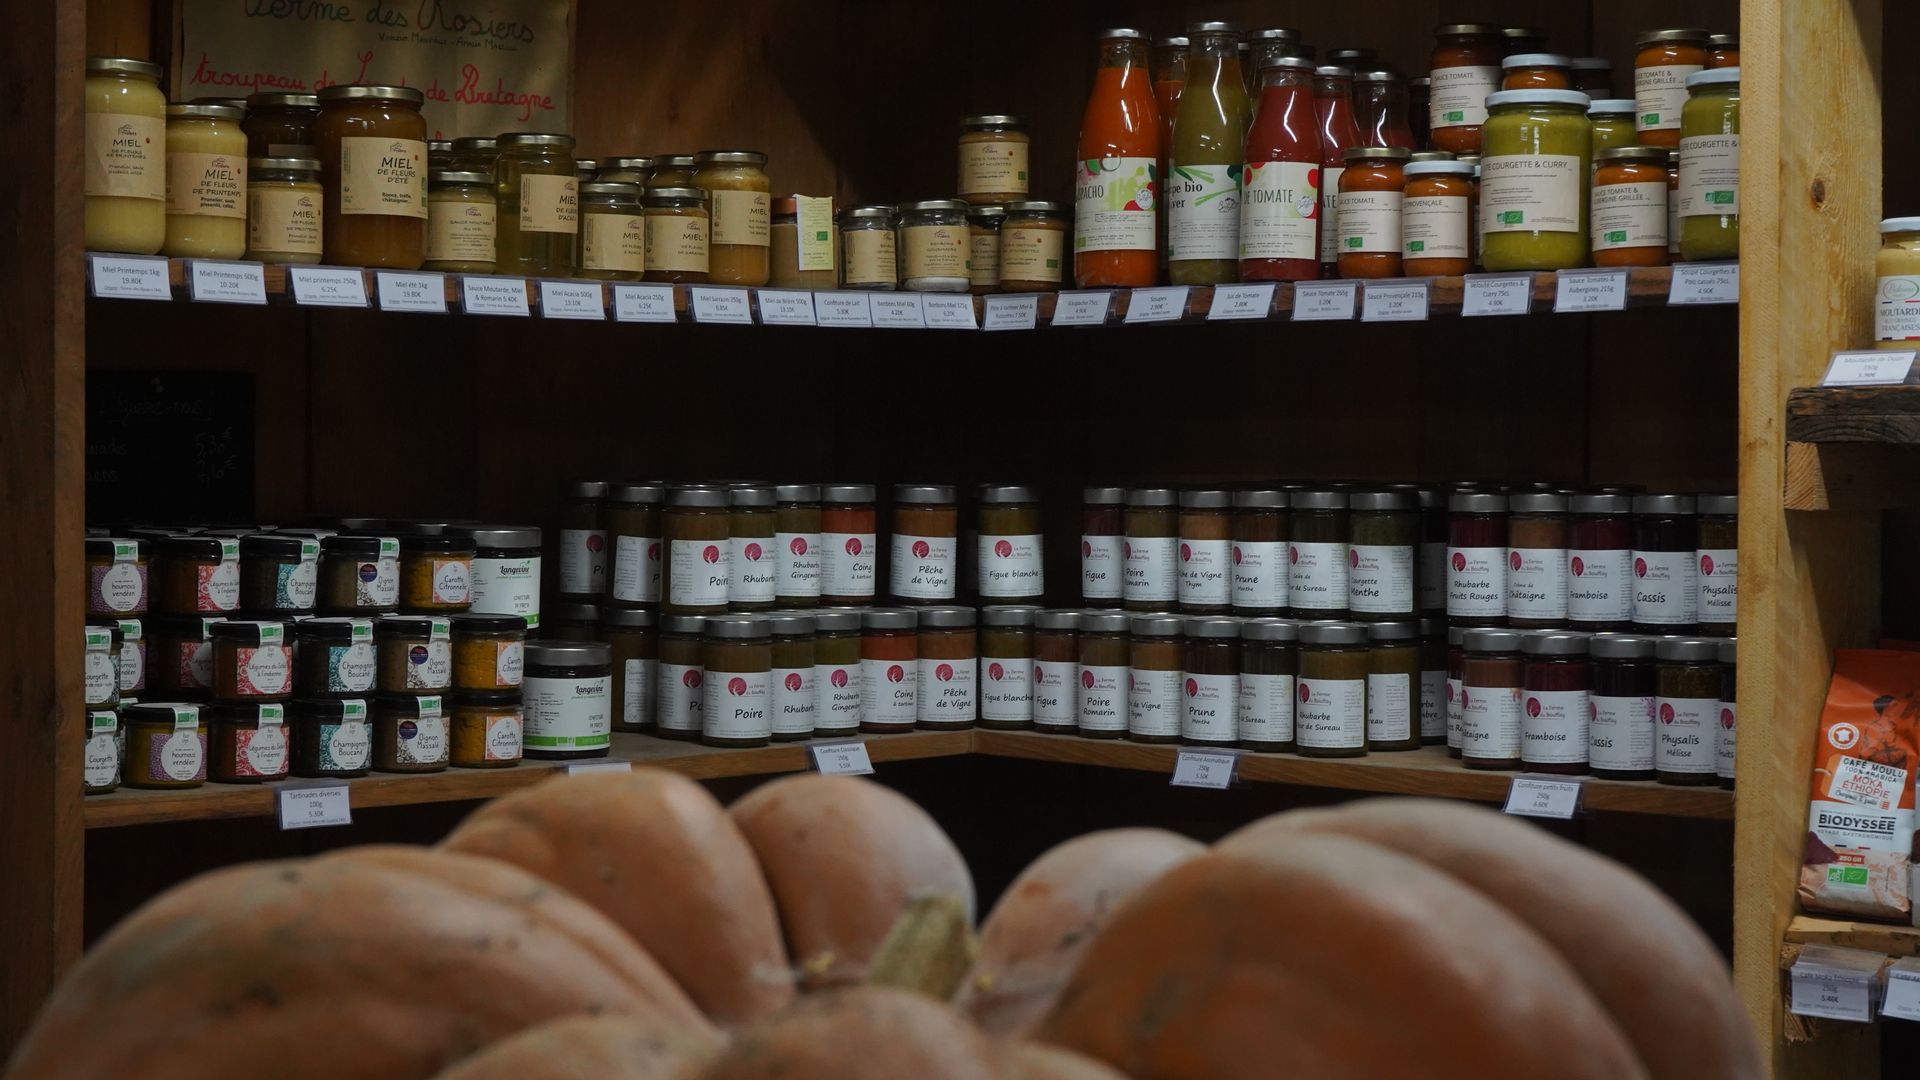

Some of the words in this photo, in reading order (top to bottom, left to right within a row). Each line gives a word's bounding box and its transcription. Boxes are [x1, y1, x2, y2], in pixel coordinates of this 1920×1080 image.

[245, 0, 356, 21] erme
[365, 0, 409, 27] des
[418, 0, 535, 42] Rosiers
[191, 53, 307, 96] troupeau
[1449, 72, 1474, 80] TOMATE
[426, 80, 450, 102] de
[456, 64, 556, 121] Bretagne
[112, 139, 142, 148] MIEL
[1689, 140, 1730, 150] COURGETTE
[1731, 140, 1738, 148] &
[381, 157, 413, 170] MIEL
[1491, 161, 1533, 171] COURGETTE
[1534, 160, 1541, 169] &
[1542, 160, 1568, 169] CURRY
[204, 169, 235, 181] MIEL
[377, 168, 388, 176] DE
[391, 169, 416, 178] FLEURS
[201, 180, 211, 188] DE
[213, 181, 238, 189] FLEURS
[1184, 181, 1203, 192] bio
[1607, 187, 1632, 195] TOMATE
[1252, 189, 1294, 204] TOMATE
[1350, 197, 1375, 205] TOMATE
[293, 210, 316, 219] MIEL
[750, 208, 768, 217] MIEL
[682, 233, 703, 242] MIEL
[102, 266, 117, 274] Miel
[117, 267, 148, 276] Printemps
[149, 267, 160, 277] 1kg
[199, 270, 212, 278] Miel
[213, 271, 243, 281] Printemps
[243, 273, 259, 282] 500g
[122, 277, 143, 285] 19.80€
[219, 281, 239, 289] 10.20€
[395, 281, 408, 289] Miel
[409, 281, 418, 289] été
[418, 282, 428, 290] 1kg
[562, 290, 580, 298] Acacia
[852, 562, 872, 572] Coing
[918, 565, 944, 574] Pêche
[989, 570, 1009, 580] Figue
[1012, 569, 1039, 578] blanche
[1085, 570, 1106, 582] Figue
[1125, 568, 1144, 577] Poire
[1201, 571, 1222, 581] Vigne
[911, 576, 922, 584] de
[925, 576, 948, 586] Vigne
[1235, 574, 1259, 584] Prune
[1454, 580, 1491, 589] Rhubarbe
[1351, 587, 1380, 597] Menthe
[1570, 591, 1608, 600] Framboise
[1702, 585, 1737, 596] Physalis
[1450, 592, 1467, 600] Fruits
[1469, 592, 1498, 602] Rouges
[1509, 591, 1546, 602] Châtaigne
[1637, 591, 1666, 604] Cassis
[1707, 599, 1732, 607] Mélisse
[894, 689, 914, 701] Coing
[943, 688, 967, 697] Pêche
[984, 692, 1001, 702] Figue
[1003, 693, 1033, 702] blanche
[936, 699, 947, 708] de
[950, 699, 971, 710] Vigne
[1036, 695, 1057, 708] Figue
[1087, 696, 1110, 706] Poire
[1141, 701, 1161, 711] Vigne
[735, 708, 763, 719] Poire
[1083, 708, 1116, 716] Romarin
[1188, 706, 1216, 717] Prune
[1299, 712, 1331, 721] Rhubarbe
[1306, 723, 1313, 731] de
[1314, 723, 1341, 732] Sureau
[418, 733, 439, 743] Oignon
[1524, 731, 1567, 741] Framboise
[1661, 734, 1700, 746] Physalis
[1666, 749, 1692, 758] Mélisse
[1843, 757, 1868, 770] CAFÉ
[1871, 763, 1905, 779] MOULU
[1853, 774, 1883, 788] MOKA
[1842, 780, 1890, 799] ÉTHIOPIE
